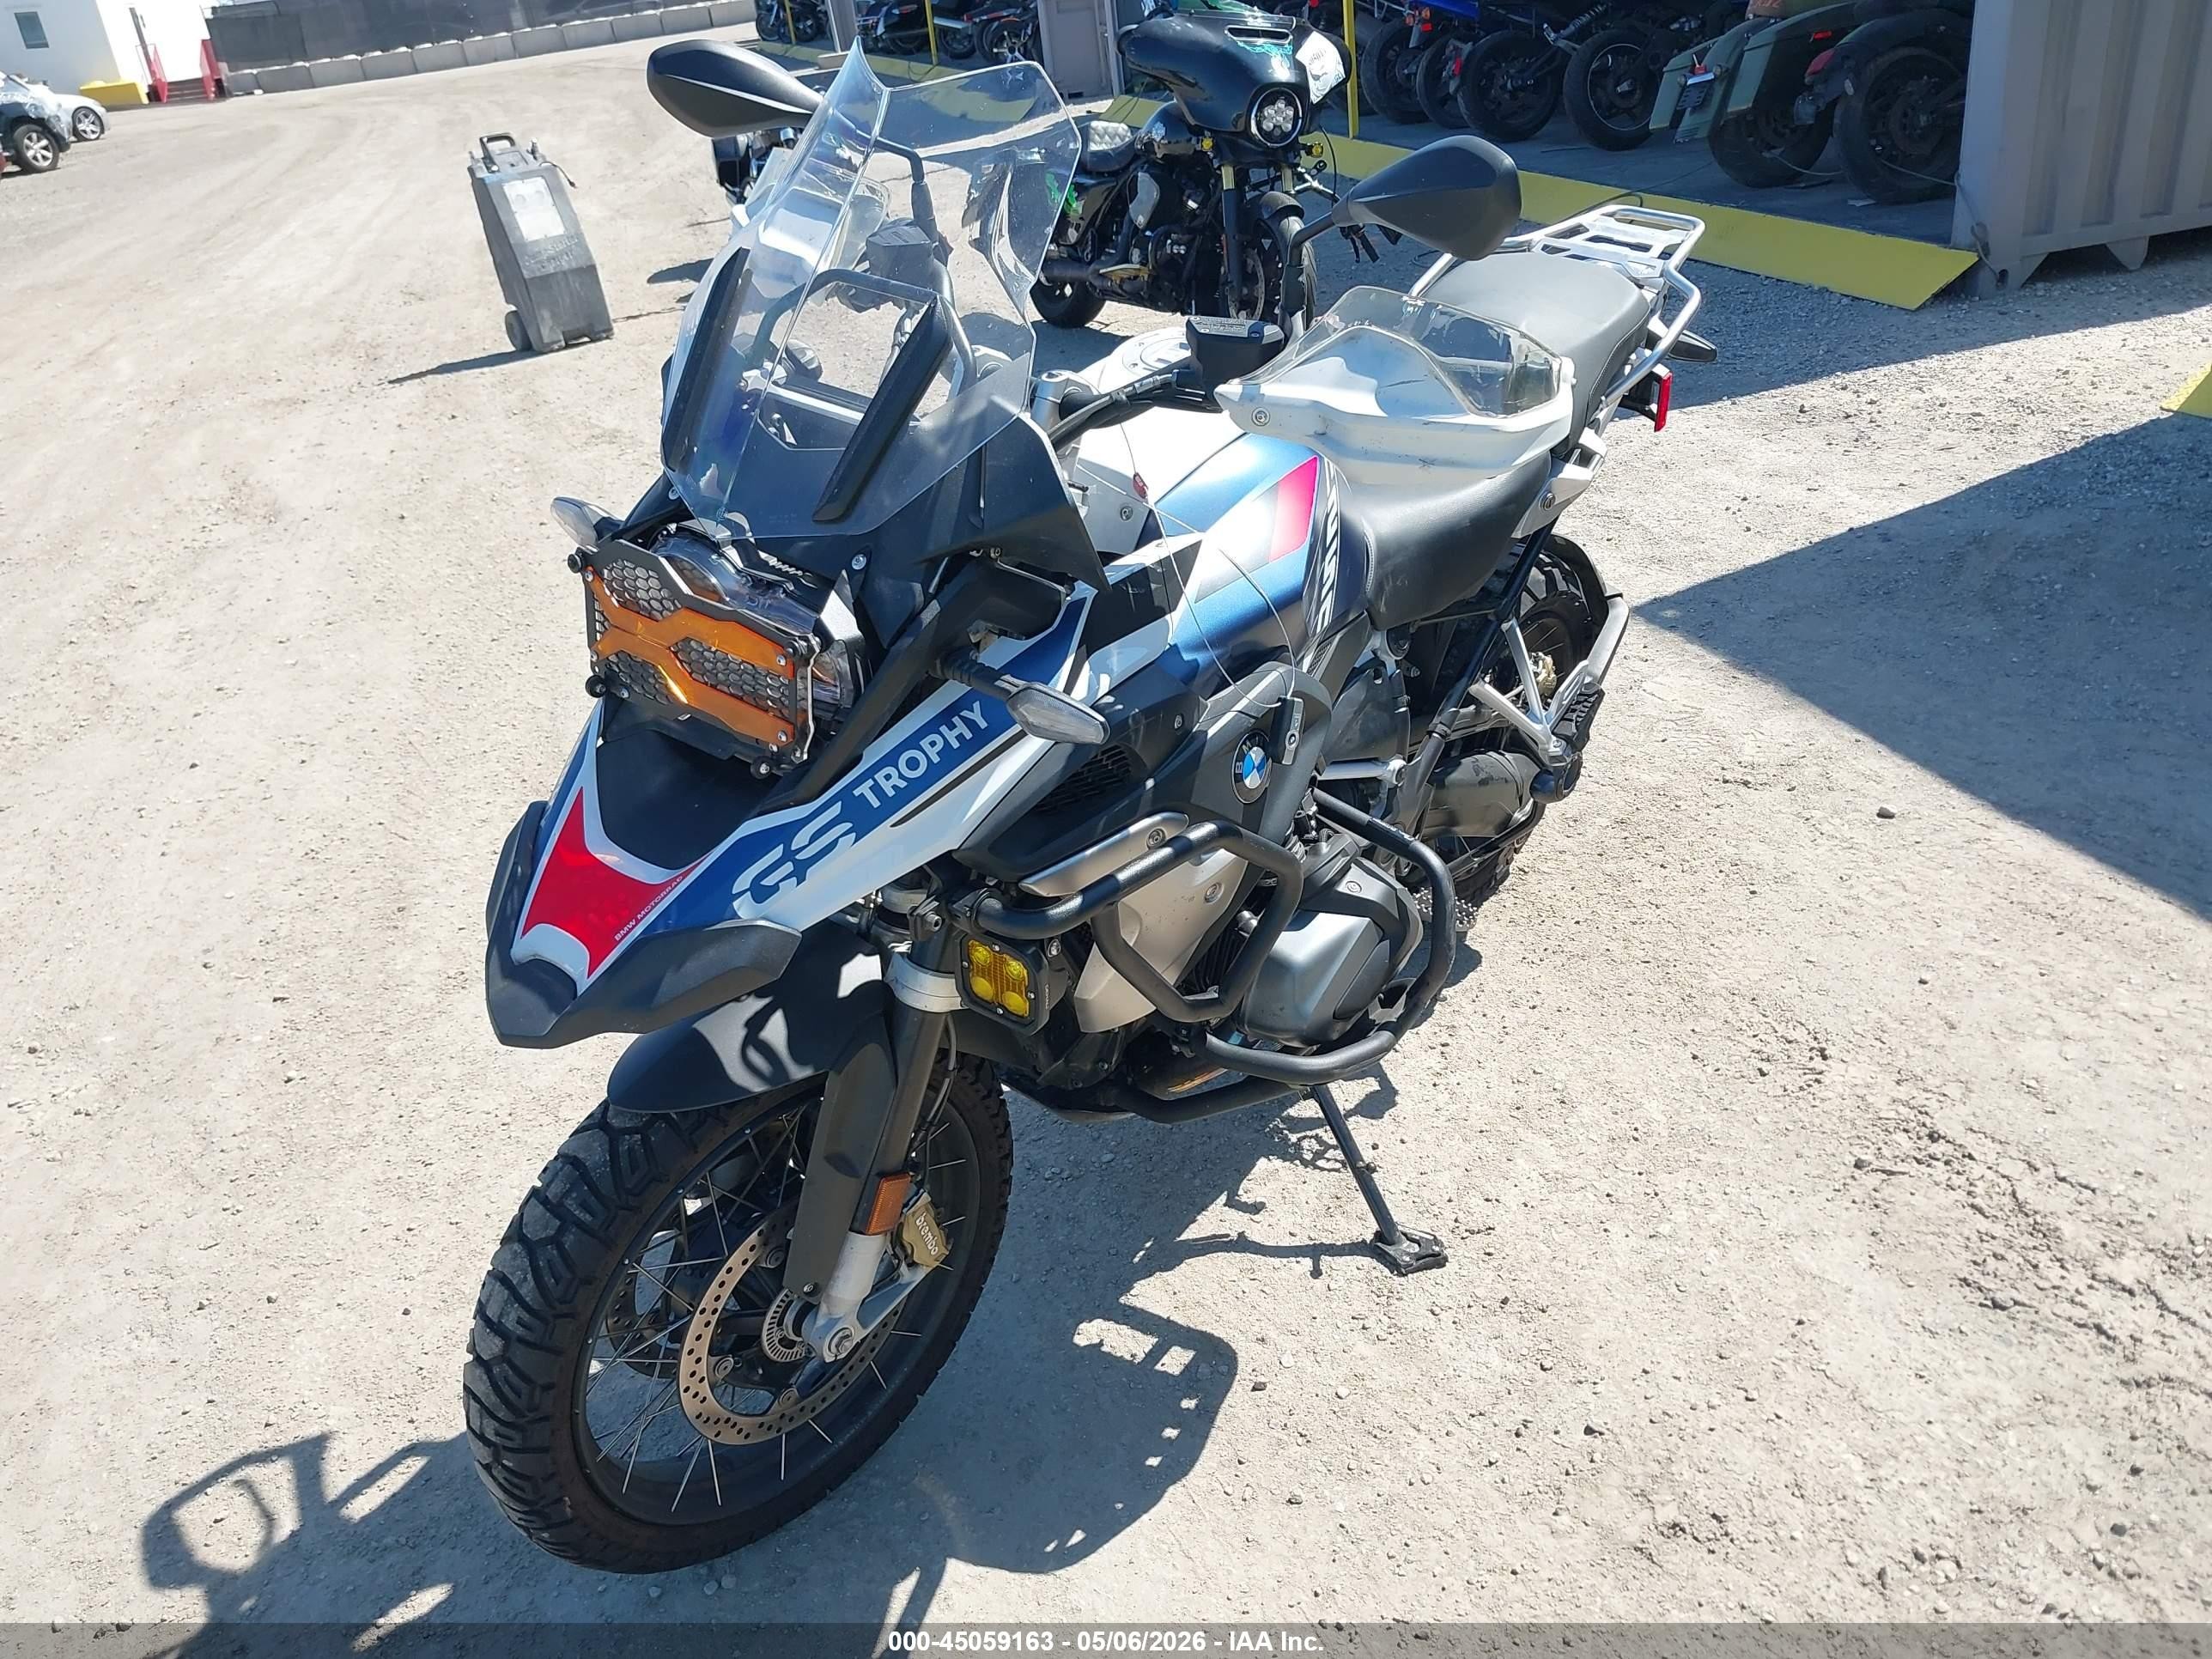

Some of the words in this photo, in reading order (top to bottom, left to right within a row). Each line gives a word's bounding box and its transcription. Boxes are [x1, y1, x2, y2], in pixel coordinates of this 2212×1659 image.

[731, 800, 857, 919] GS
[852, 700, 989, 809] TROPHY
[613, 918, 637, 942] BMW
[636, 875, 684, 921] MOTORRAD
[915, 1212, 939, 1255] brembo
